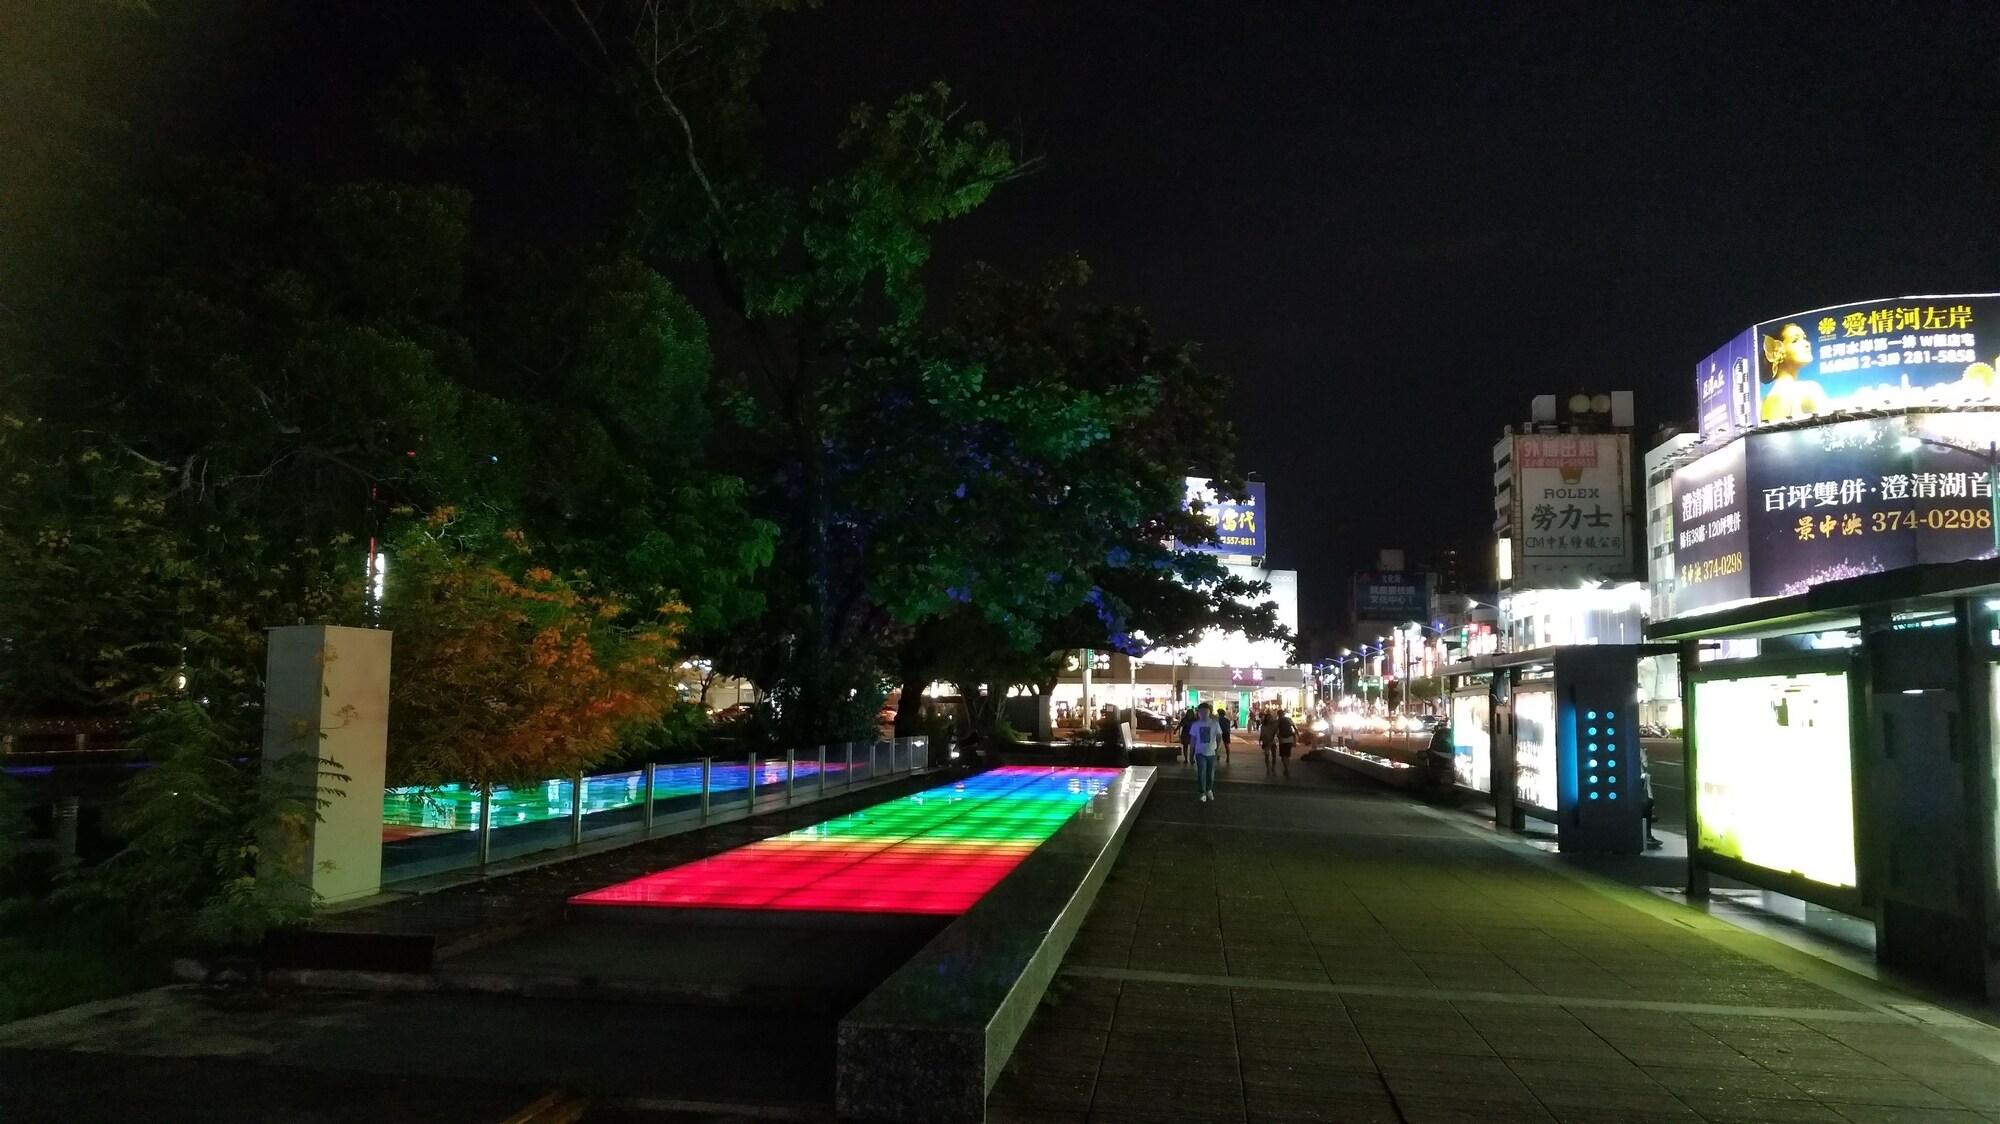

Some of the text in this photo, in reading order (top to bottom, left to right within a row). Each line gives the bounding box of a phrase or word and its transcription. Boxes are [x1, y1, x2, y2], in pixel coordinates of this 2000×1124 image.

[1842, 305, 1973, 338] 愛情河左岸
[1544, 488, 1600, 499] ROLEX
[1531, 503, 1613, 531] 勞力士
[1872, 508, 1991, 533] 374-0298
[1703, 551, 1743, 580] 374-0298
